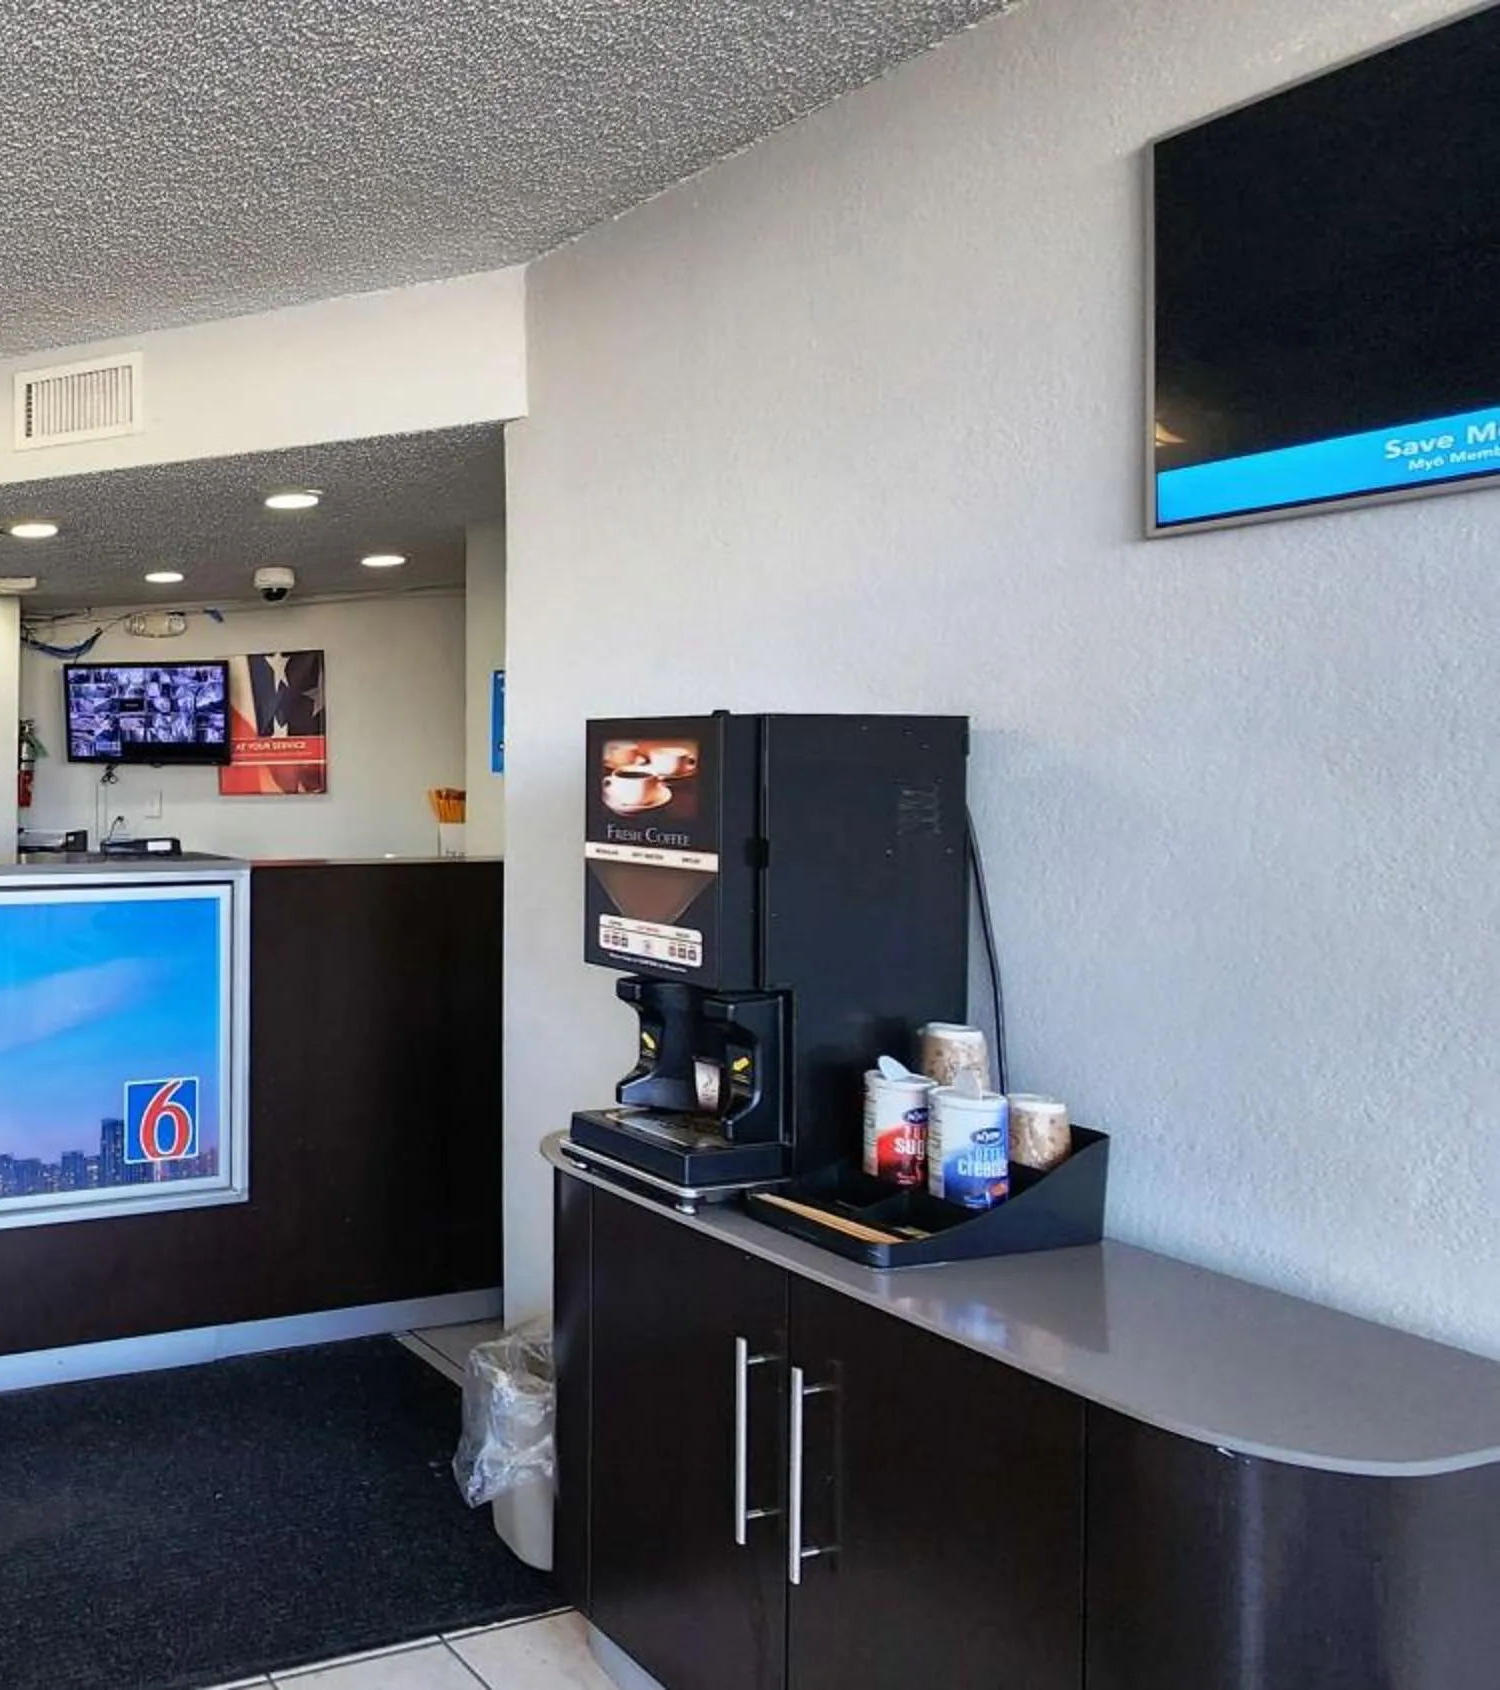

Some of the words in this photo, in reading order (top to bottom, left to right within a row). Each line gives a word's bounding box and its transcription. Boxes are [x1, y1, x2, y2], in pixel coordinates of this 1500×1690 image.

[1384, 436, 1454, 458] Save
[1466, 421, 1500, 444] M
[139, 1077, 193, 1161] 6
[894, 1137, 925, 1161] sug
